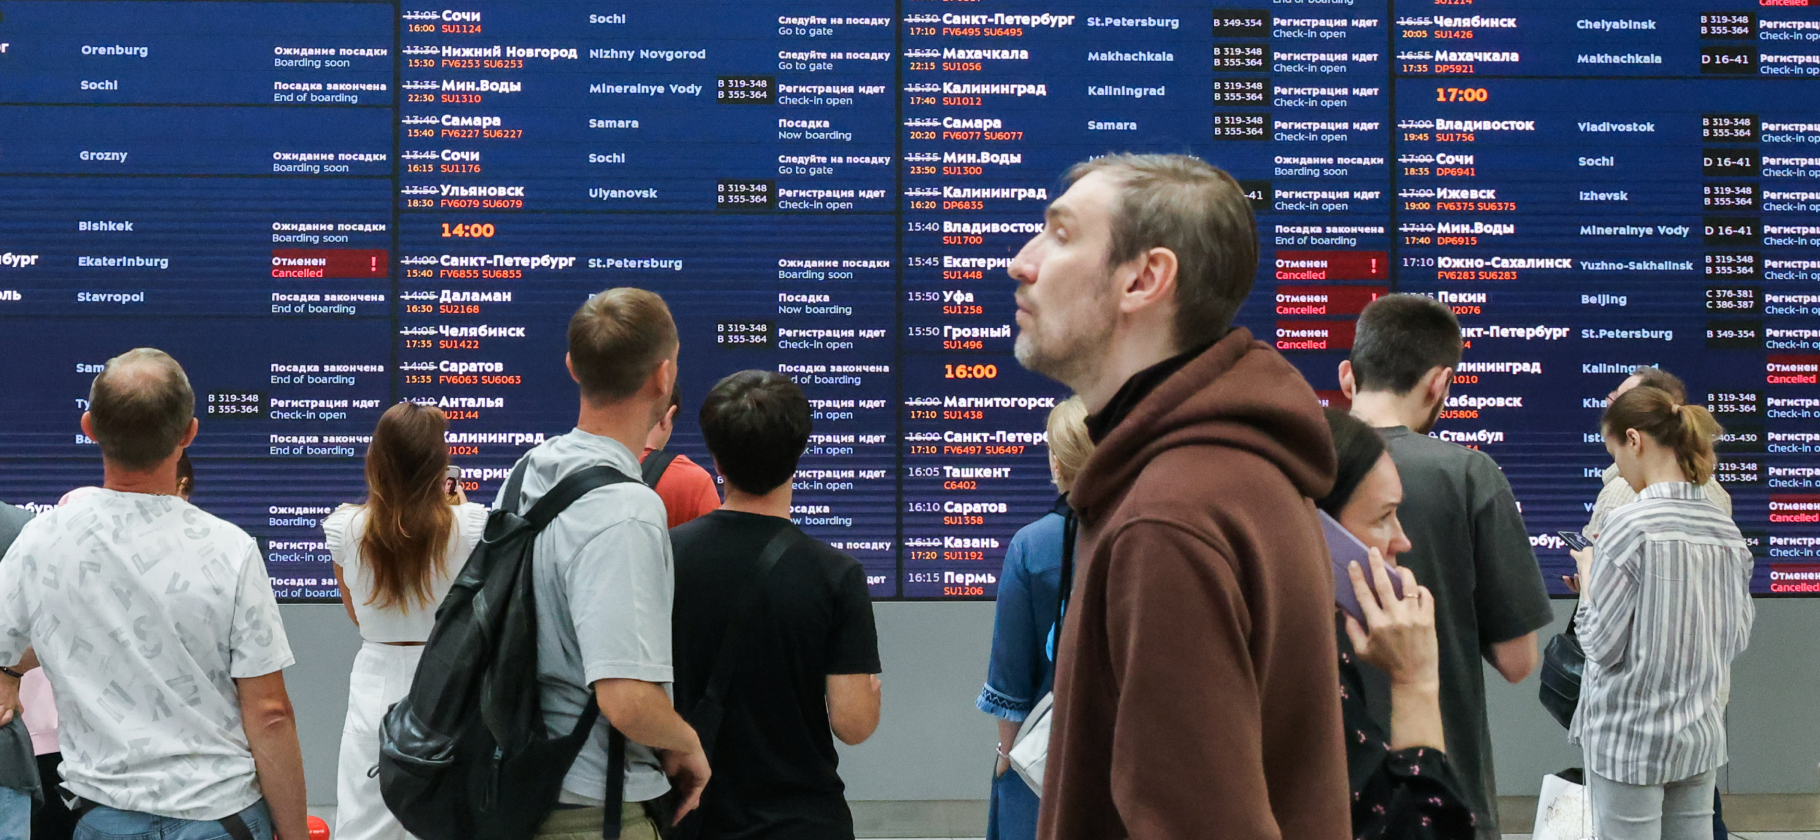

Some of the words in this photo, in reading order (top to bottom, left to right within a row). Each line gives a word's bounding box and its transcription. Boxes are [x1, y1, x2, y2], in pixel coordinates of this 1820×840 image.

[442, 10, 481, 22] Сочи
[589, 13, 626, 24] Sochi
[778, 15, 827, 26] Следуйте
[846, 18, 890, 27] посадку
[942, 13, 1075, 28] Санкт-Петербург
[1434, 15, 1517, 28] Челябинск
[1701, 15, 1708, 23] B
[1710, 15, 1749, 24] 319-348
[1087, 17, 1179, 29] St.Petersburg
[1214, 19, 1220, 27] B
[1223, 19, 1262, 27] 349-354
[1273, 17, 1347, 28] Регистрация
[1351, 19, 1378, 28] идет
[1576, 19, 1656, 32] Chelyabinsk
[409, 24, 435, 32] 16:00
[441, 24, 482, 33] SU1124
[778, 26, 793, 35] Go
[795, 27, 806, 35] to
[809, 27, 833, 37] gate
[1701, 26, 1708, 34] B
[1711, 26, 1749, 34] 355-364
[1273, 29, 1317, 38] Check-in
[1319, 31, 1346, 40] open
[1402, 30, 1428, 38] 20:05
[1434, 30, 1473, 39] SU1426
[81, 45, 148, 58] Orenburg
[274, 47, 336, 56] Ожидание
[339, 48, 387, 57] посадки
[442, 45, 501, 57] Нижний
[506, 46, 578, 60] Новгород
[590, 48, 635, 61] Nizhny
[640, 49, 706, 61] Novgorod
[943, 47, 1029, 59] Махачкала
[1088, 51, 1174, 61] Makhachkala
[1435, 50, 1519, 62] Махачкала
[274, 58, 321, 69] Boarding
[409, 59, 435, 67] 15:30
[442, 59, 480, 68] FV6253
[483, 59, 523, 68] SU6253
[1577, 53, 1662, 64] Makhachkala
[1702, 55, 1711, 64] D
[1715, 55, 1749, 64] 16-41
[910, 62, 936, 70] 22:15
[942, 62, 982, 71] SU1056
[81, 80, 118, 90] Sochi
[274, 81, 322, 91] Посадка
[326, 83, 387, 91] закончена
[441, 79, 521, 93] Мин.Воды
[718, 79, 725, 87] B
[728, 80, 767, 88] 319-348
[589, 83, 665, 96] Mineralnye
[669, 83, 702, 96] Vody
[718, 90, 725, 99] B
[728, 90, 767, 99] 355-364
[779, 84, 854, 95] Регистрация
[858, 86, 886, 95] идет
[943, 82, 1047, 97] Калининград
[1088, 85, 1165, 98] Kaliningrad
[1437, 88, 1488, 102] 17:00
[274, 93, 294, 102] End
[297, 92, 308, 102] of
[310, 93, 358, 104] boarding
[408, 94, 435, 102] 22:30
[441, 94, 482, 103] SU1310
[778, 95, 823, 105] Check-in
[826, 98, 853, 107] open
[441, 114, 501, 129] Самара
[589, 119, 639, 128] Samara
[779, 119, 830, 129] Посадка
[1088, 120, 1137, 130] Samara
[1436, 118, 1535, 132] Владивосток
[1577, 122, 1655, 132] Vladivostok
[779, 131, 802, 139] Now
[805, 130, 852, 141] boarding
[80, 151, 128, 163] Grozny
[943, 151, 1021, 165] Мин.Воды
[440, 184, 524, 197] Ульяновск
[589, 188, 657, 200] Ulyanovsk
[1437, 187, 1496, 199] Ижевск
[1580, 190, 1628, 201] Izhevsk
[79, 221, 133, 231] Bishkek
[442, 223, 495, 238] 14:00
[908, 222, 940, 231] 15:40
[943, 222, 1044, 234] Владивосток
[78, 256, 169, 269] Ekaterinburg
[272, 257, 326, 266] Отменен
[440, 254, 576, 269] Санкт-Петербург
[588, 258, 682, 271] St.Petersburg
[1275, 259, 1328, 268] Отменен
[1403, 258, 1434, 267] 17:10
[1438, 256, 1572, 268] Южно-Сахалинск
[1580, 261, 1693, 270] Yuzhno-Sakhalinsk
[271, 268, 324, 278] Cancelled
[1275, 270, 1326, 280] Cancelled
[1438, 271, 1476, 280] FV6283
[1478, 271, 1517, 280] SU6283
[77, 291, 144, 304] Stavropol
[439, 290, 511, 304] Даламан
[908, 292, 940, 301] 15:50
[942, 290, 974, 303] Уфа
[1438, 291, 1486, 303] Пекин
[1706, 290, 1713, 298] C
[1716, 290, 1753, 298] 376-381
[1581, 294, 1627, 306] Beijing
[439, 324, 525, 337] Челябинск
[908, 327, 940, 336] 15:50
[944, 324, 1011, 338] Грозный
[1581, 328, 1673, 341] St.Petersburg
[406, 340, 432, 348] 17:35
[439, 340, 479, 349] SU1422
[943, 340, 983, 349] SU1496
[271, 363, 319, 373] Посадка
[439, 360, 503, 375] Саратов
[945, 364, 997, 379] 16:00
[1766, 363, 1818, 372] Отменен
[271, 375, 290, 384] End
[293, 374, 305, 384] of
[307, 375, 355, 386] boarding
[1767, 374, 1817, 384] Cancelled
[208, 394, 215, 402] B
[218, 394, 259, 402] 319-348
[271, 398, 348, 409] Регистрация
[352, 400, 380, 409] идет
[438, 396, 504, 408] Анталья
[944, 397, 1054, 410] Магнитогорск
[208, 405, 215, 413] B
[218, 405, 259, 413] 355-364
[911, 410, 937, 419] 17:10
[943, 410, 983, 419] SU1438
[270, 410, 316, 419] Check-in
[319, 412, 346, 421] open
[1439, 430, 1504, 443] Стамбул
[909, 467, 940, 477] 16:05
[943, 466, 1011, 478] Ташкент
[943, 481, 977, 490] C6402
[269, 506, 331, 516] Ожидание
[909, 502, 941, 512] 16:10
[944, 501, 1007, 516] Саратов
[269, 517, 316, 528] Boarding
[943, 516, 984, 525] SU1358
[944, 536, 999, 548] Казань
[911, 551, 937, 560] 17:20
[943, 551, 984, 560] SU1192
[909, 573, 940, 582] 16:15
[944, 571, 996, 586] Пермь
[944, 586, 984, 595] SU1206
